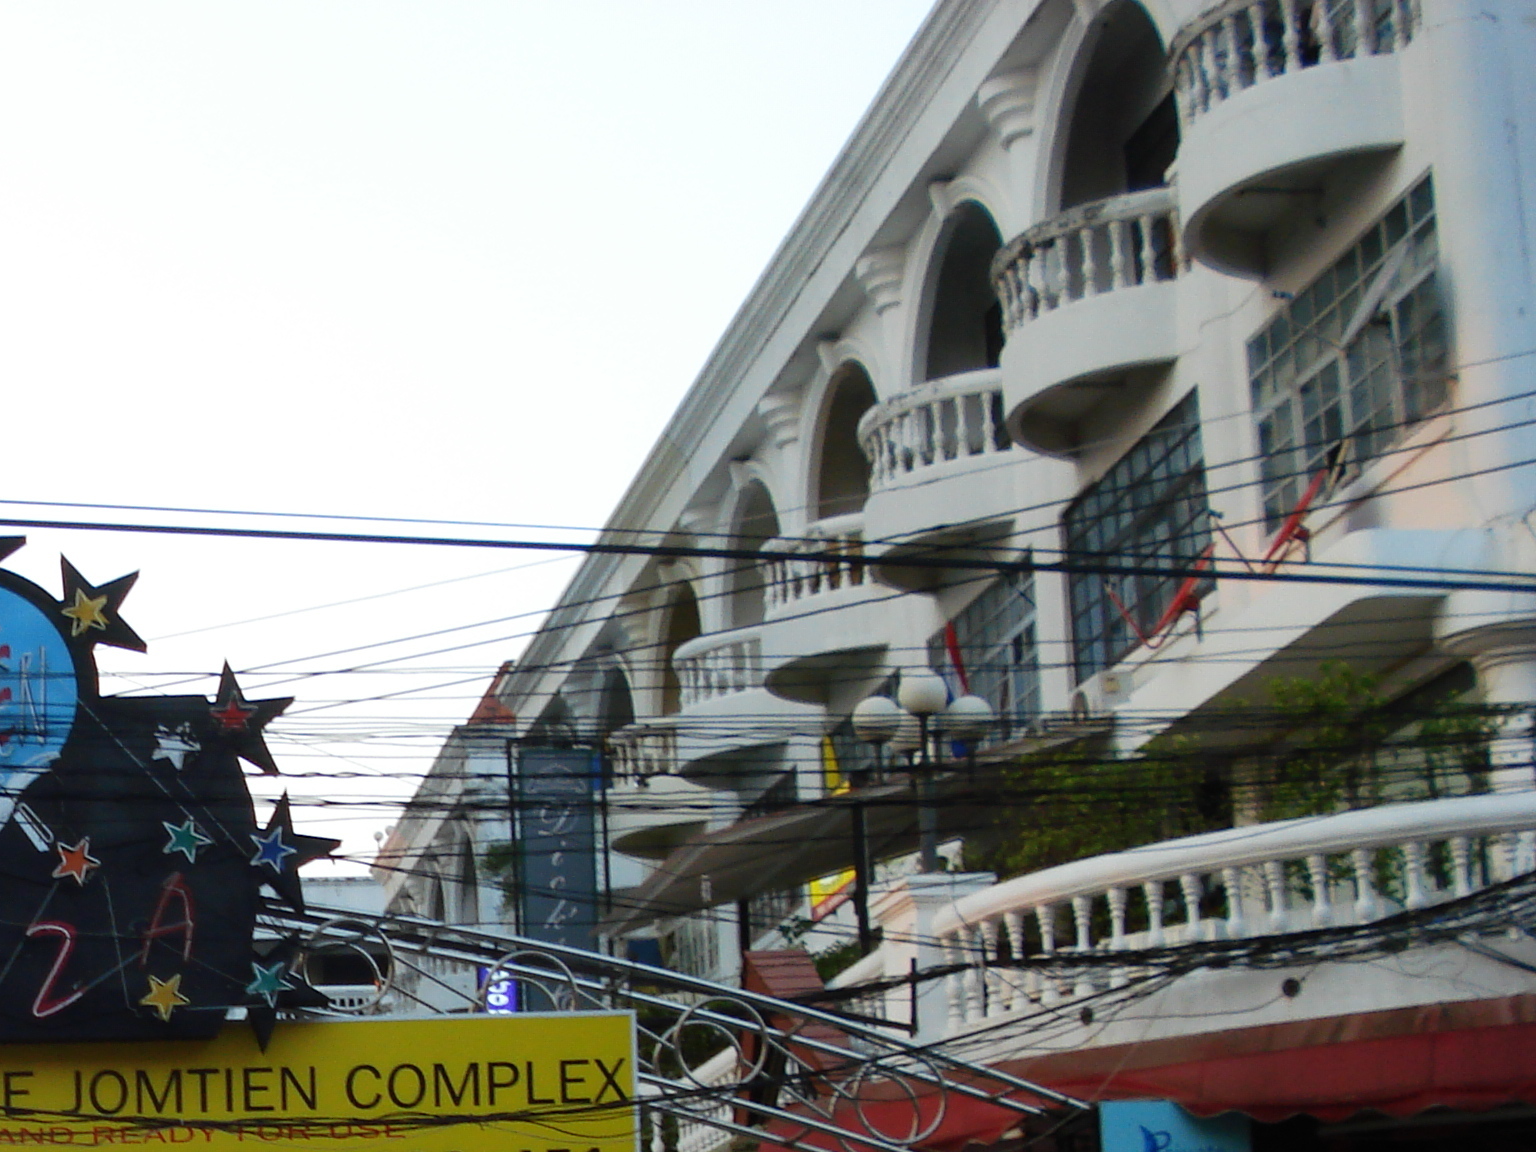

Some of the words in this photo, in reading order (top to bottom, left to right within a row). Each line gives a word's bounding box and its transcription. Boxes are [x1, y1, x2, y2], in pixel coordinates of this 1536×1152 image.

[67, 1065, 317, 1117] JOMTIEN
[345, 1056, 629, 1111] COMPLEX
[91, 1121, 215, 1145] READY
